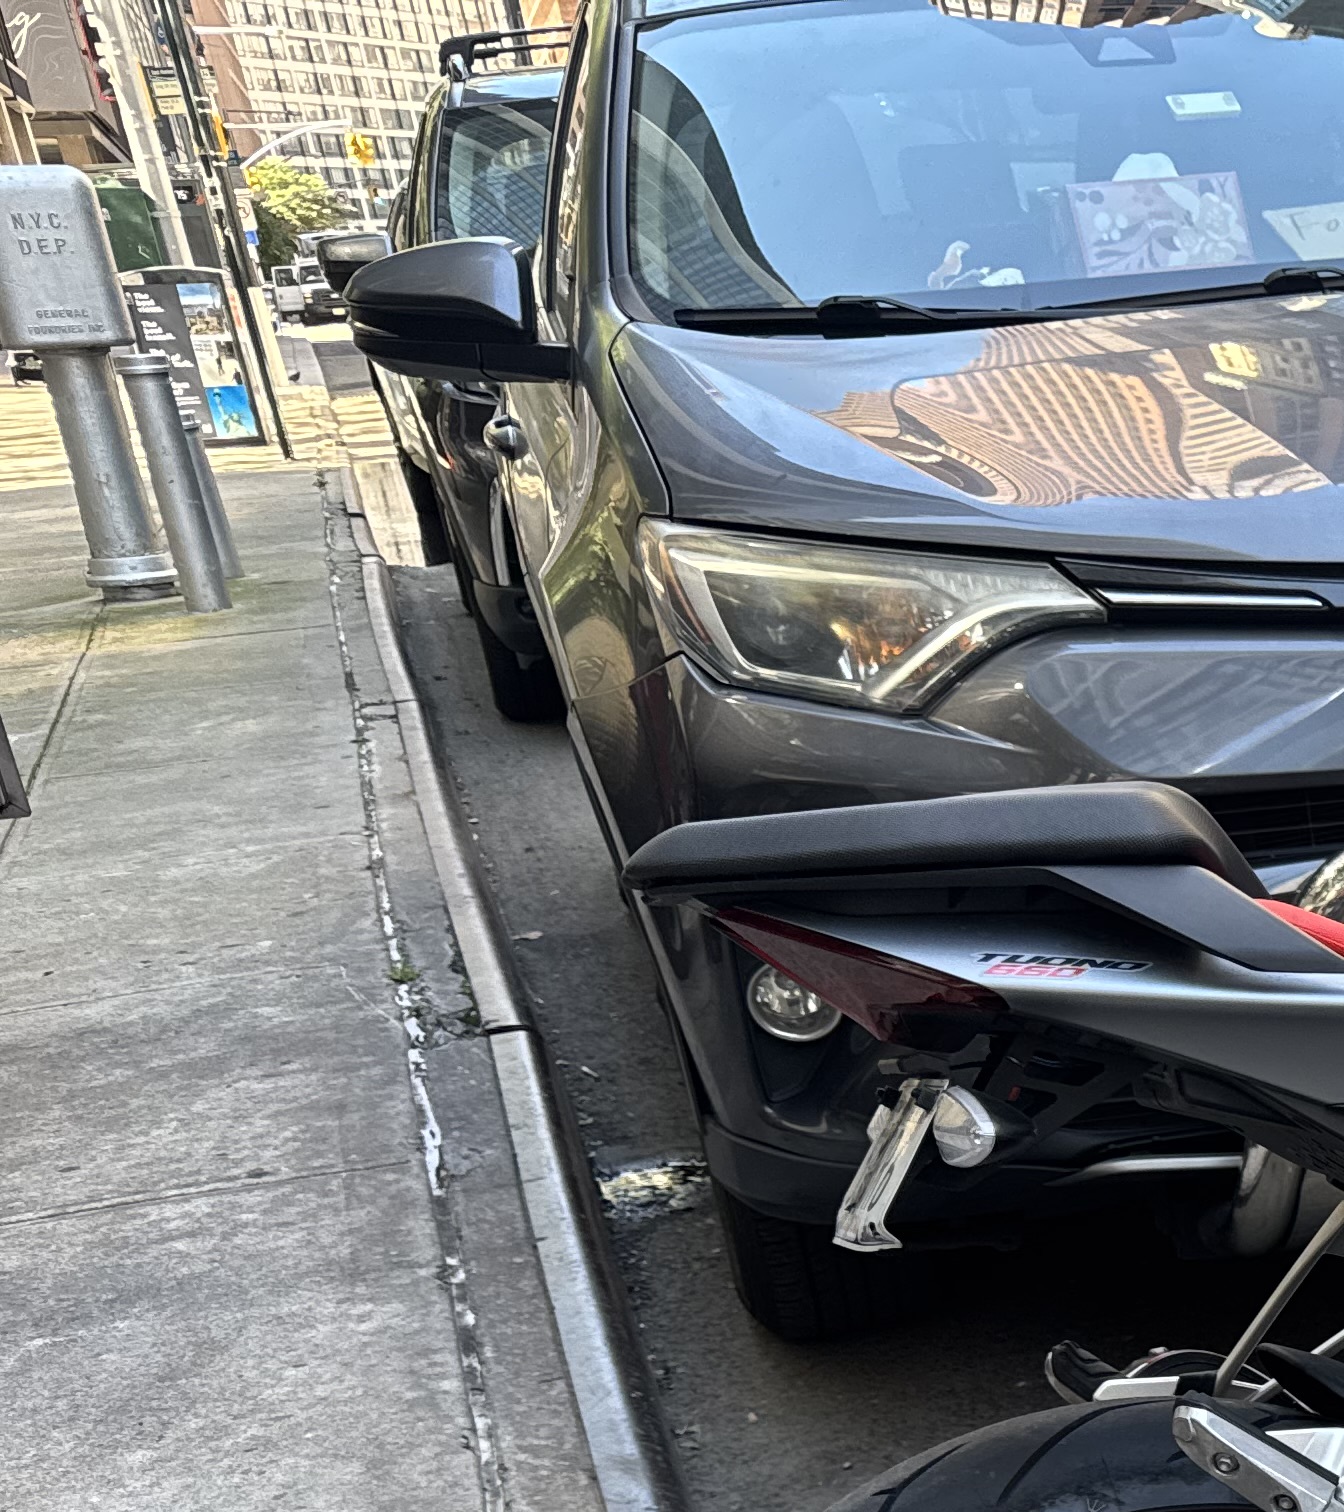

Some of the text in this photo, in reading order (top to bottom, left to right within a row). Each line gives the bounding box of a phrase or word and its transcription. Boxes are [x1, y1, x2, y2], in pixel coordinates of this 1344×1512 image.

[9, 211, 69, 230] N.Y.C.
[18, 237, 75, 255] D.E.P.
[36, 309, 89, 319] GENERAL
[977, 953, 1148, 970] TUONO
[984, 964, 1087, 977] 660
